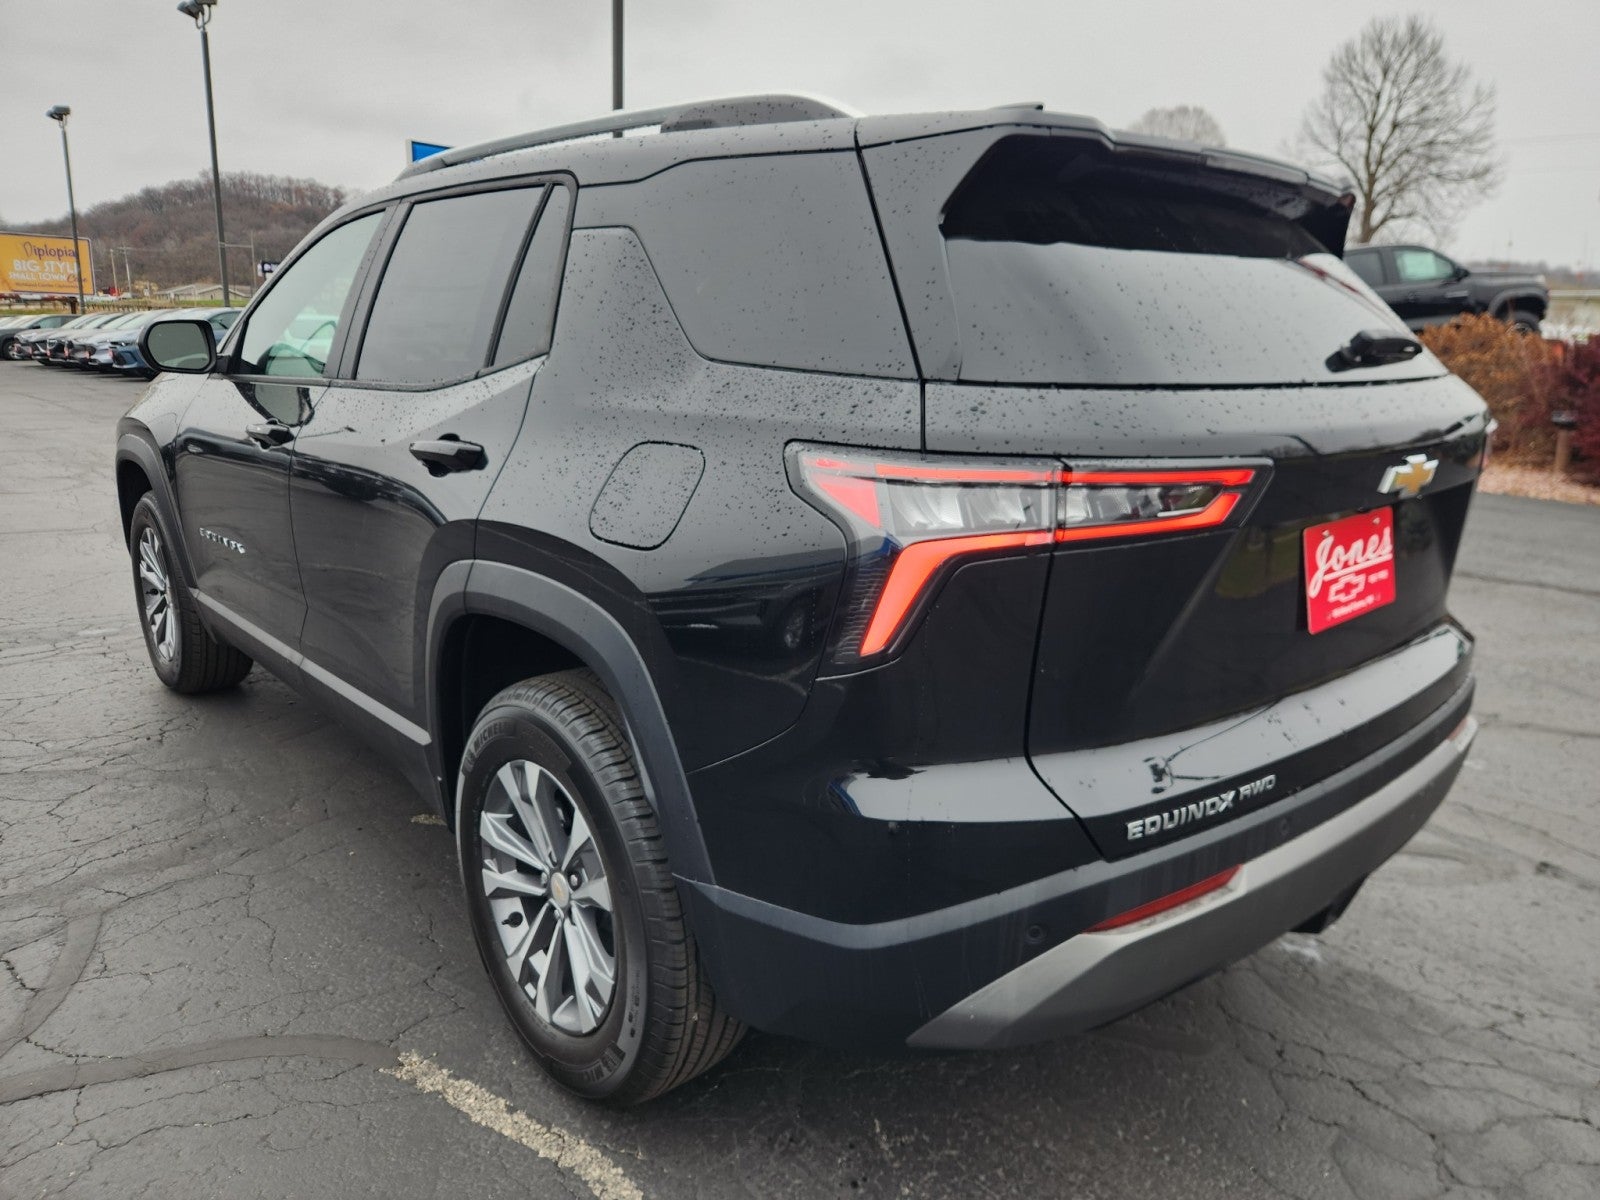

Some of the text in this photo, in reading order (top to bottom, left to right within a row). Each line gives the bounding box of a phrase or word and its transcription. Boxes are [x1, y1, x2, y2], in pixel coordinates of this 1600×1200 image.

[13, 260, 40, 272] BIG
[23, 241, 77, 260] Diplopia
[1309, 526, 1393, 599] Jones
[1126, 790, 1236, 840] EQUINOX
